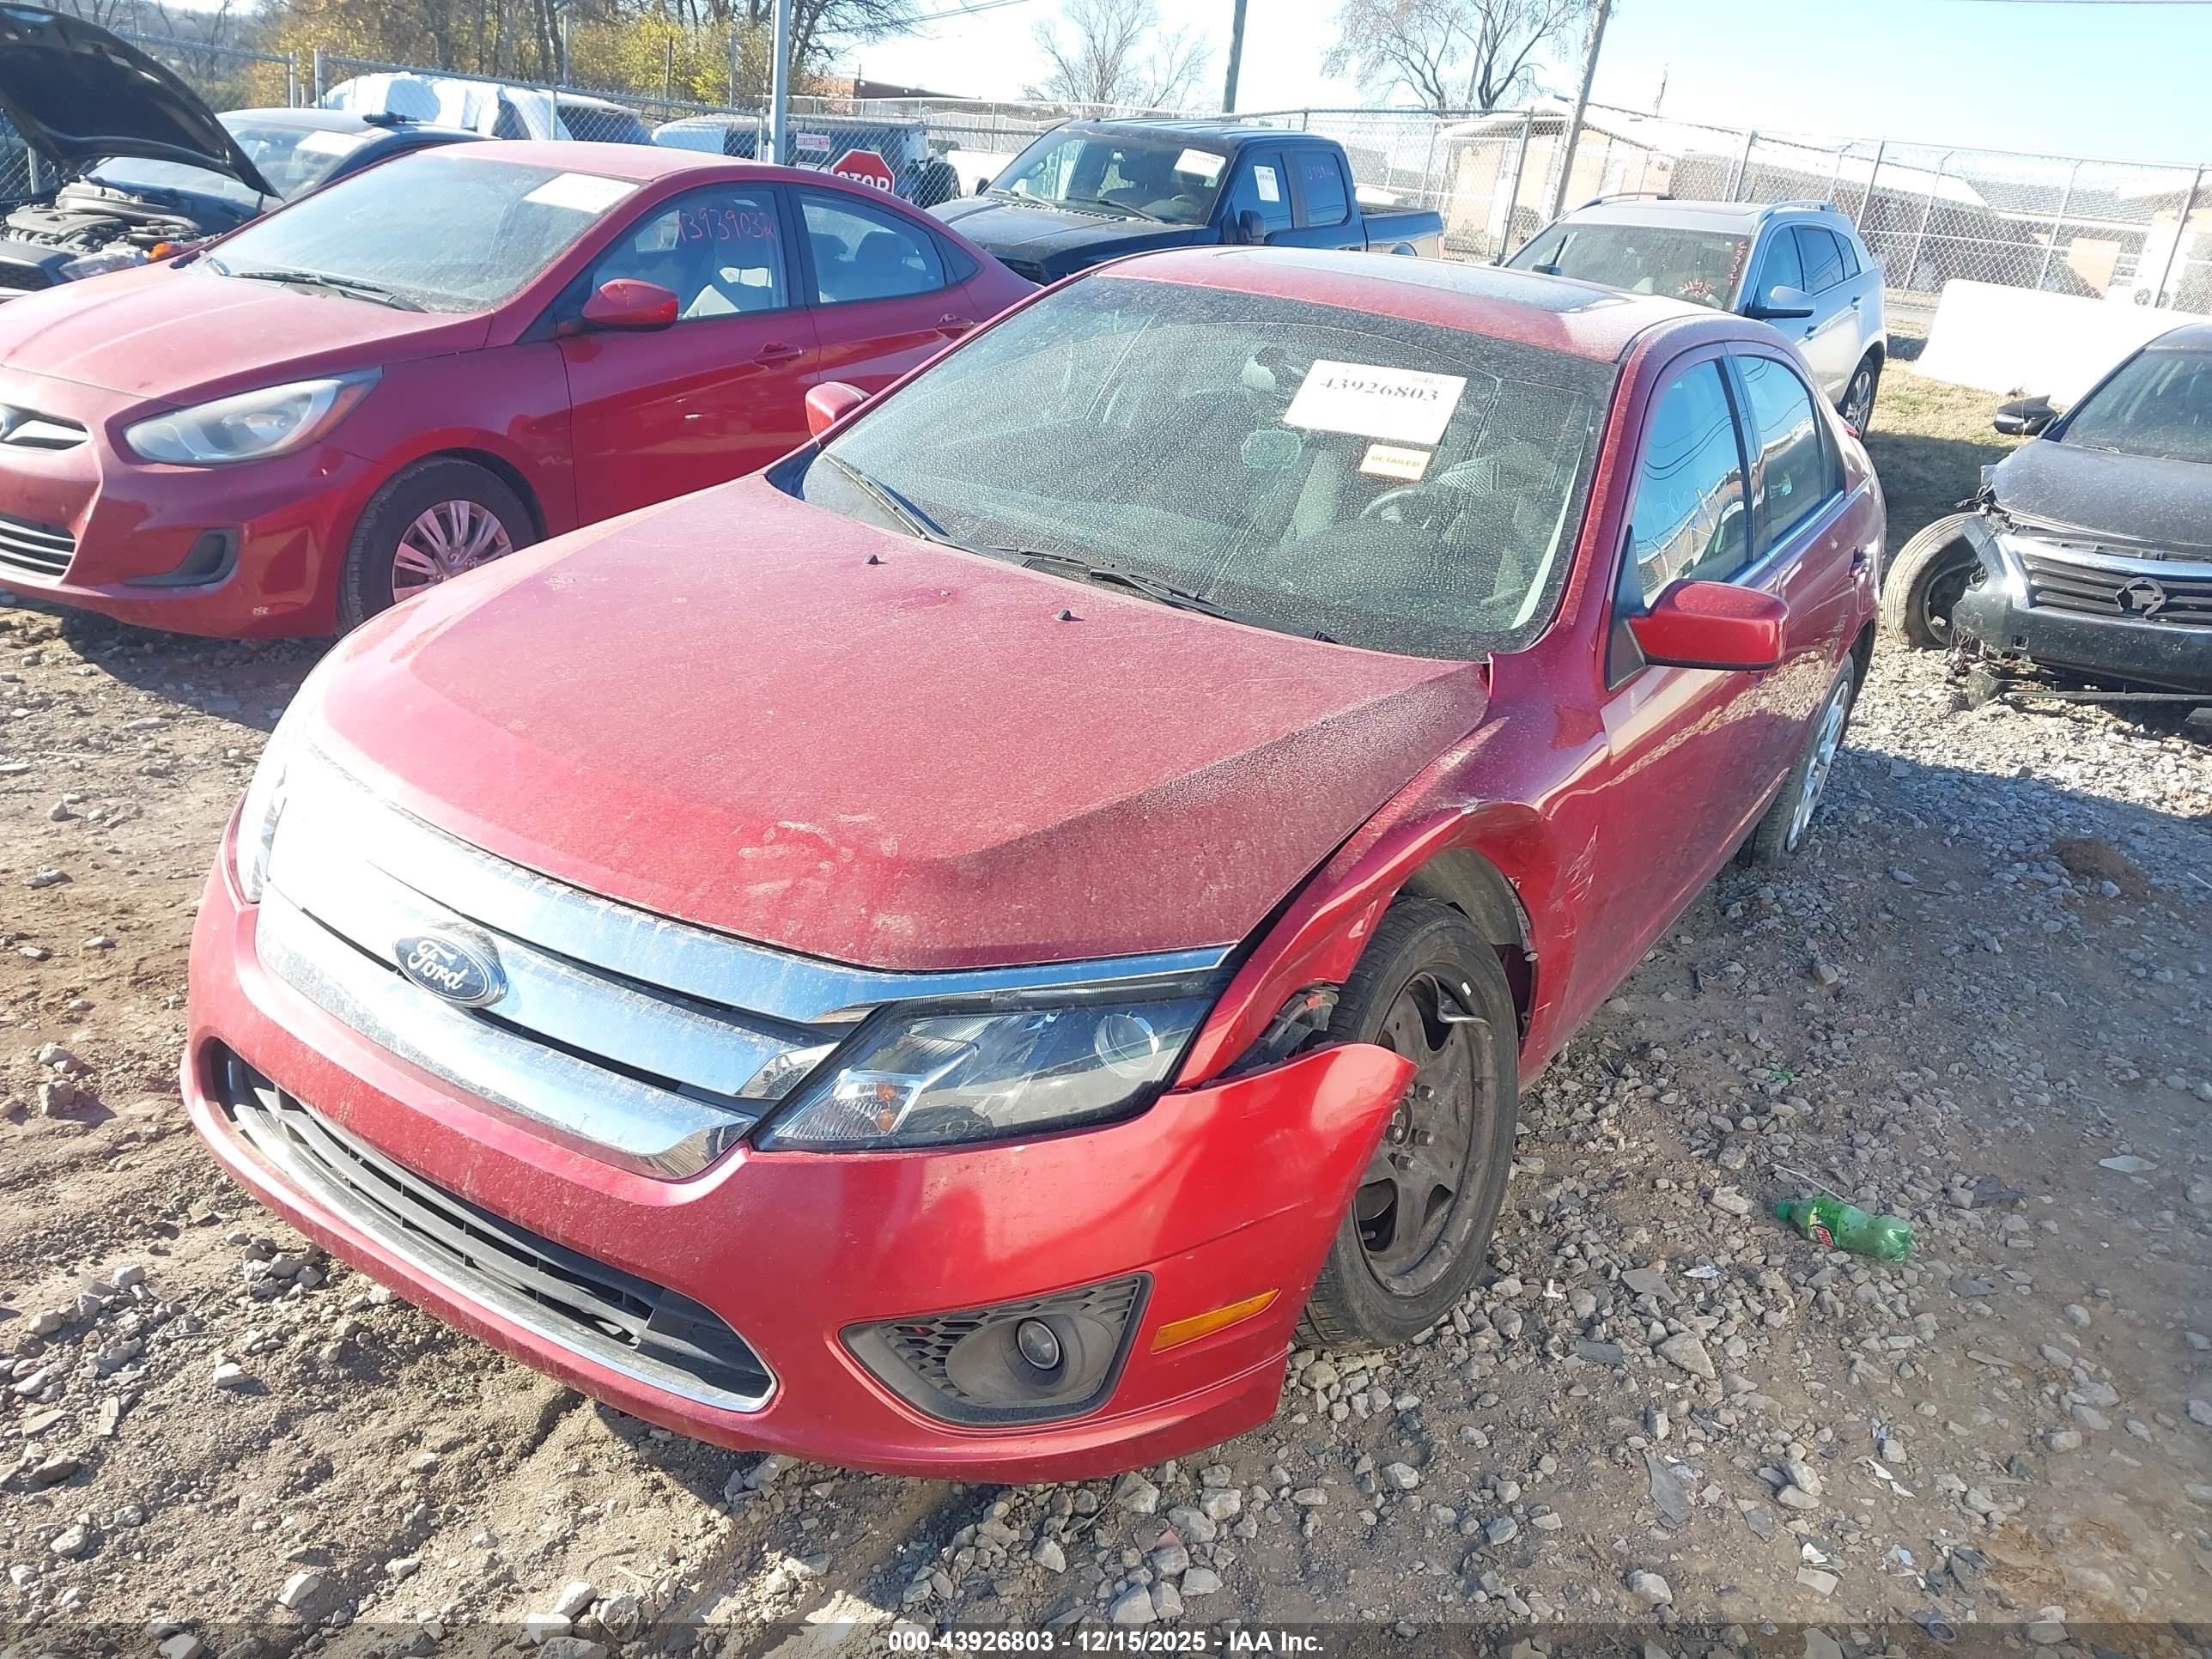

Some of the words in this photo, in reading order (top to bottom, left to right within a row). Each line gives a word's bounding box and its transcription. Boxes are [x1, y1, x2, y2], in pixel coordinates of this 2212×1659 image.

[1320, 377, 1439, 402] 43926803
[1370, 454, 1420, 468] DETAILED
[407, 939, 469, 990] Ford
